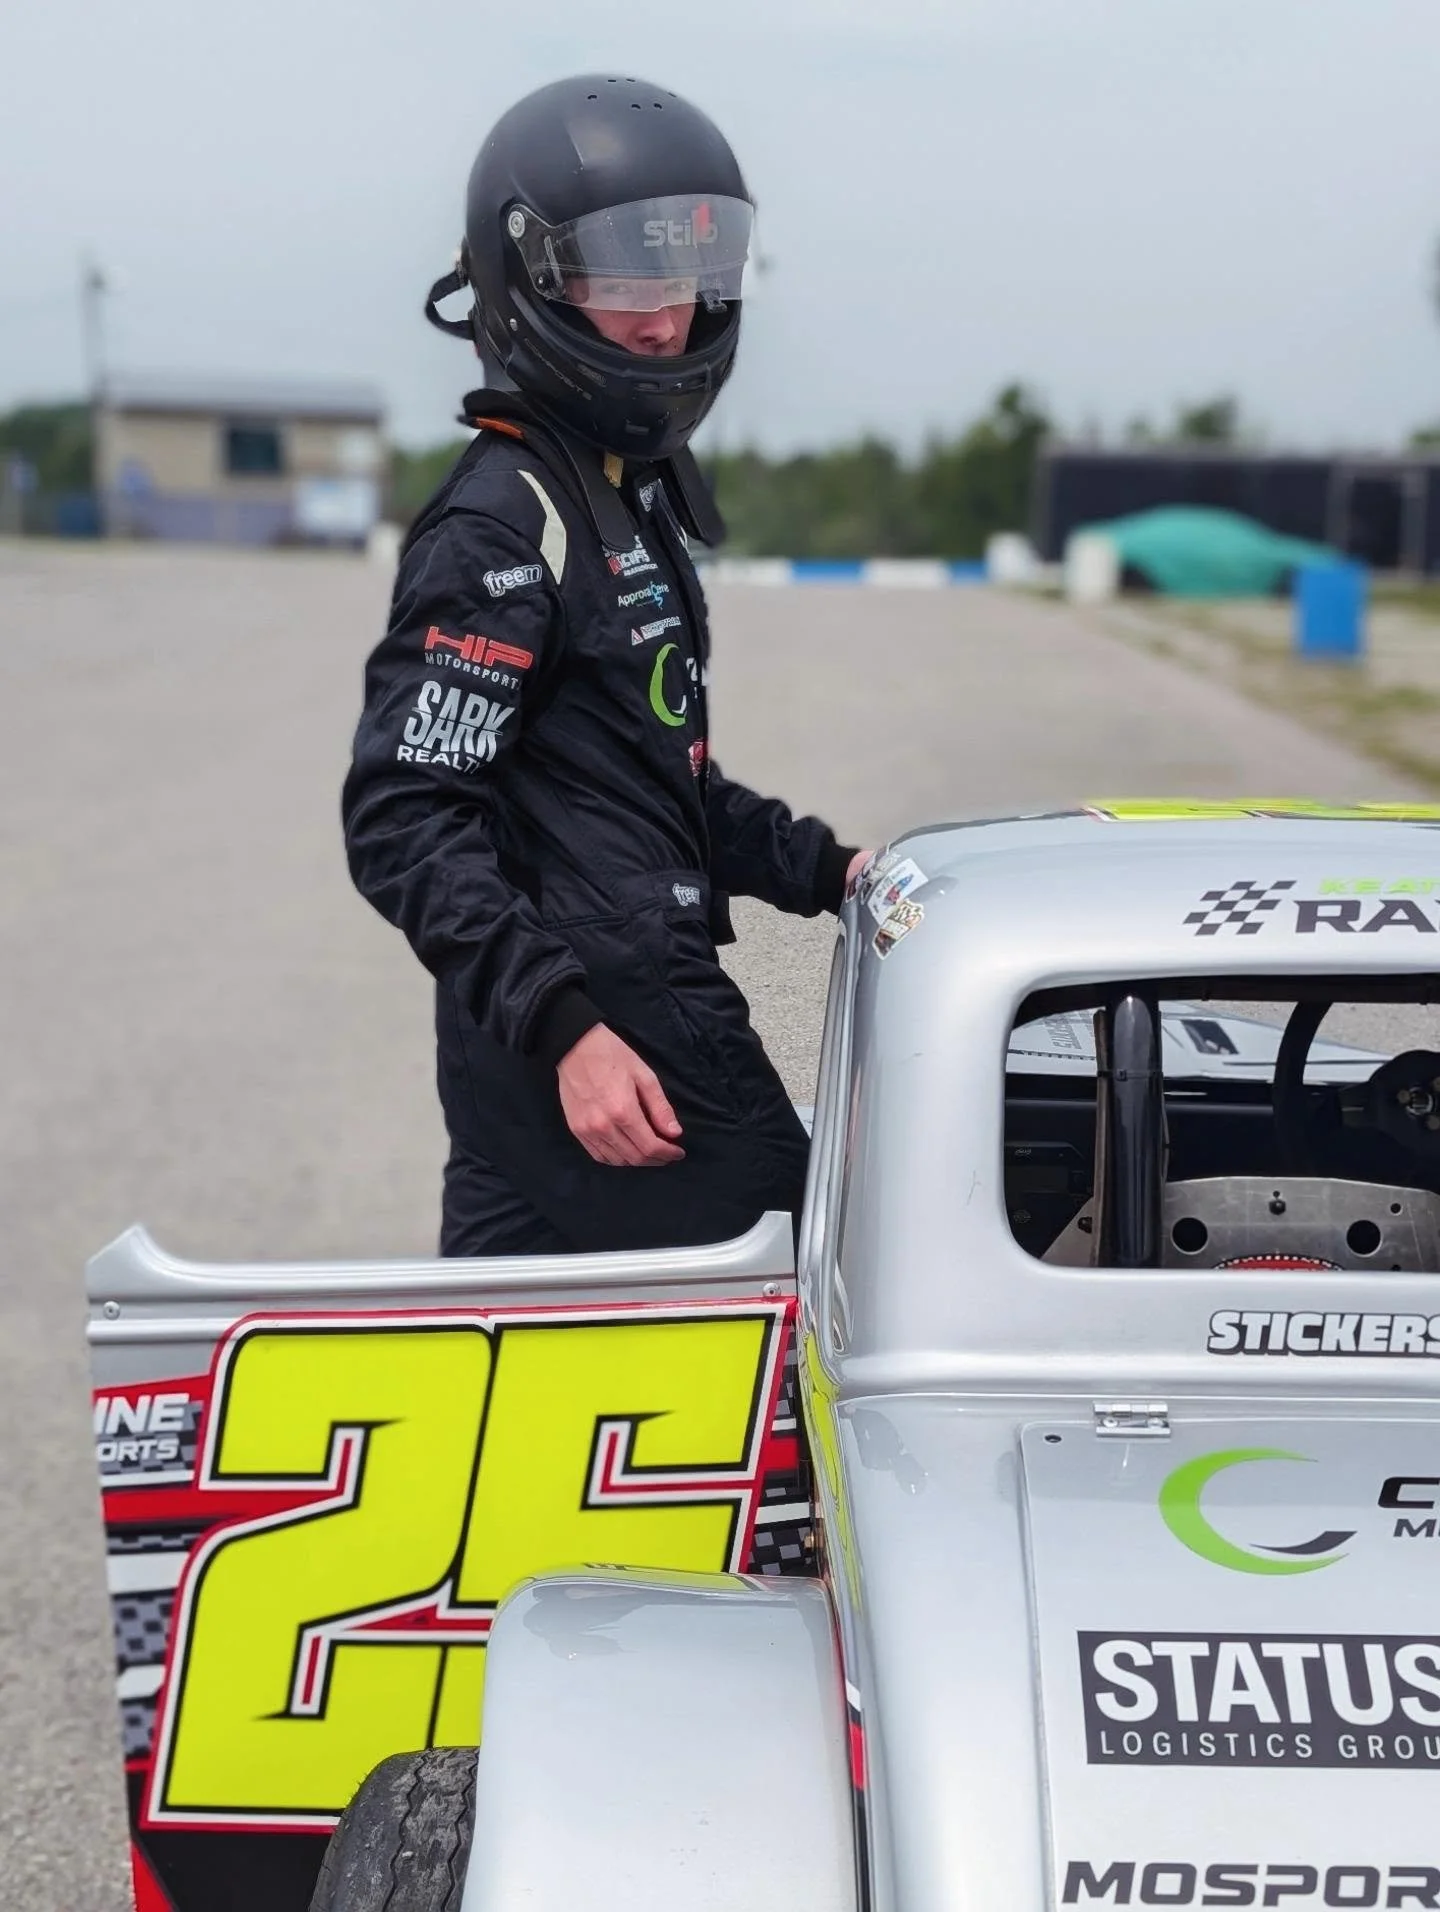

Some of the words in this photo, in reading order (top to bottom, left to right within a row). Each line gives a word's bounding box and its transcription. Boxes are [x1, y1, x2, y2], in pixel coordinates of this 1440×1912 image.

[484, 565, 542, 597] freem
[425, 626, 534, 669] HIP
[425, 652, 521, 691] MOTORSPORT
[403, 680, 515, 763] SARK
[1293, 900, 1440, 933] RA
[1093, 1640, 1440, 1728] STATUS
[1100, 1730, 1312, 1758] LOGISTICS
[1338, 1734, 1440, 1760] GROU
[1062, 1860, 1440, 1909] MOSPOR
